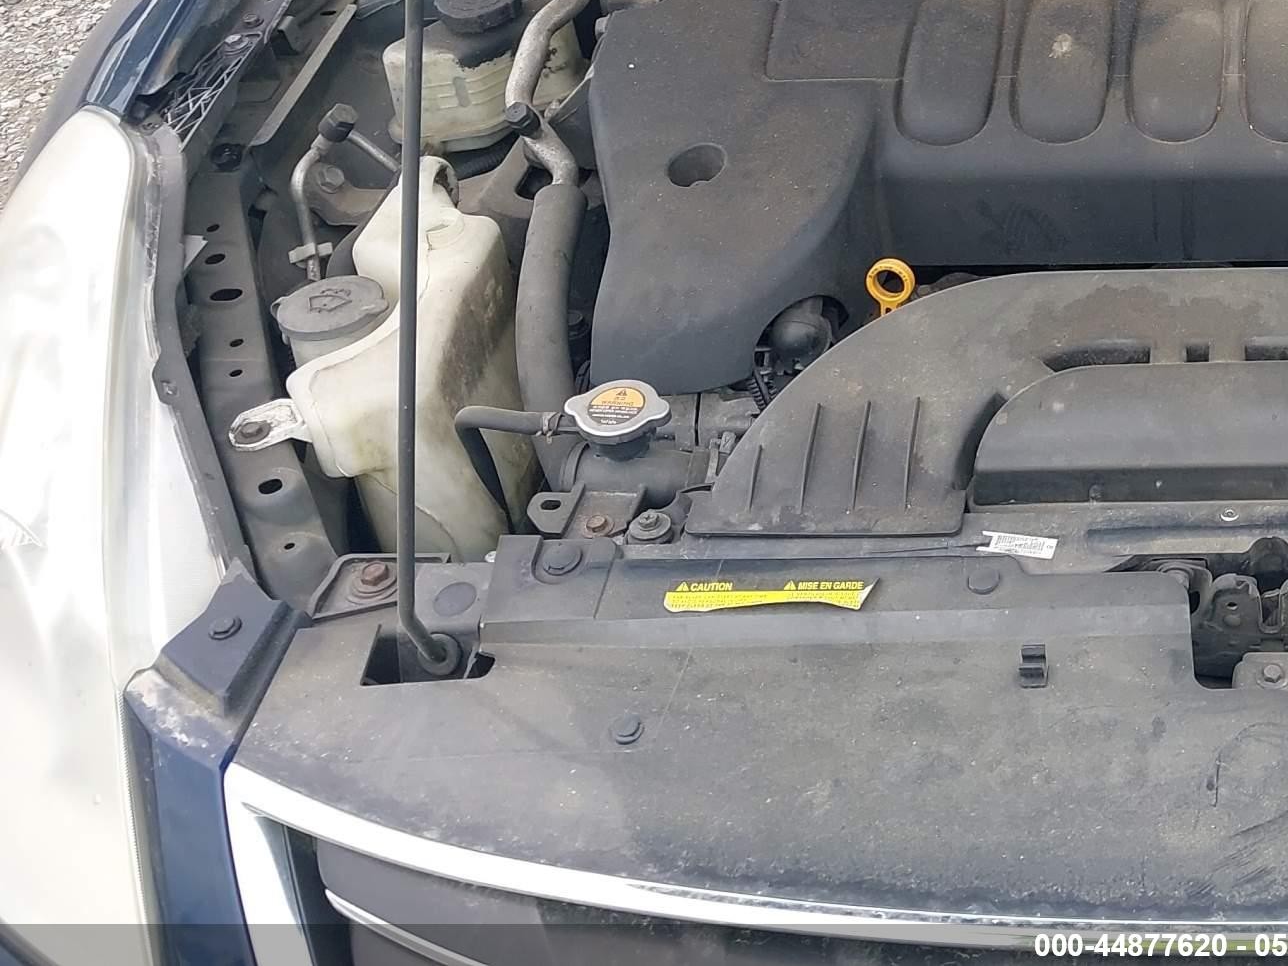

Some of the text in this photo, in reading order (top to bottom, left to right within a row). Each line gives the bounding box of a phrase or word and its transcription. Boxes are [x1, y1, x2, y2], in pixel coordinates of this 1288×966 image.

[690, 582, 733, 592] CAUTION
[797, 581, 865, 590] MISE EN GARDE
